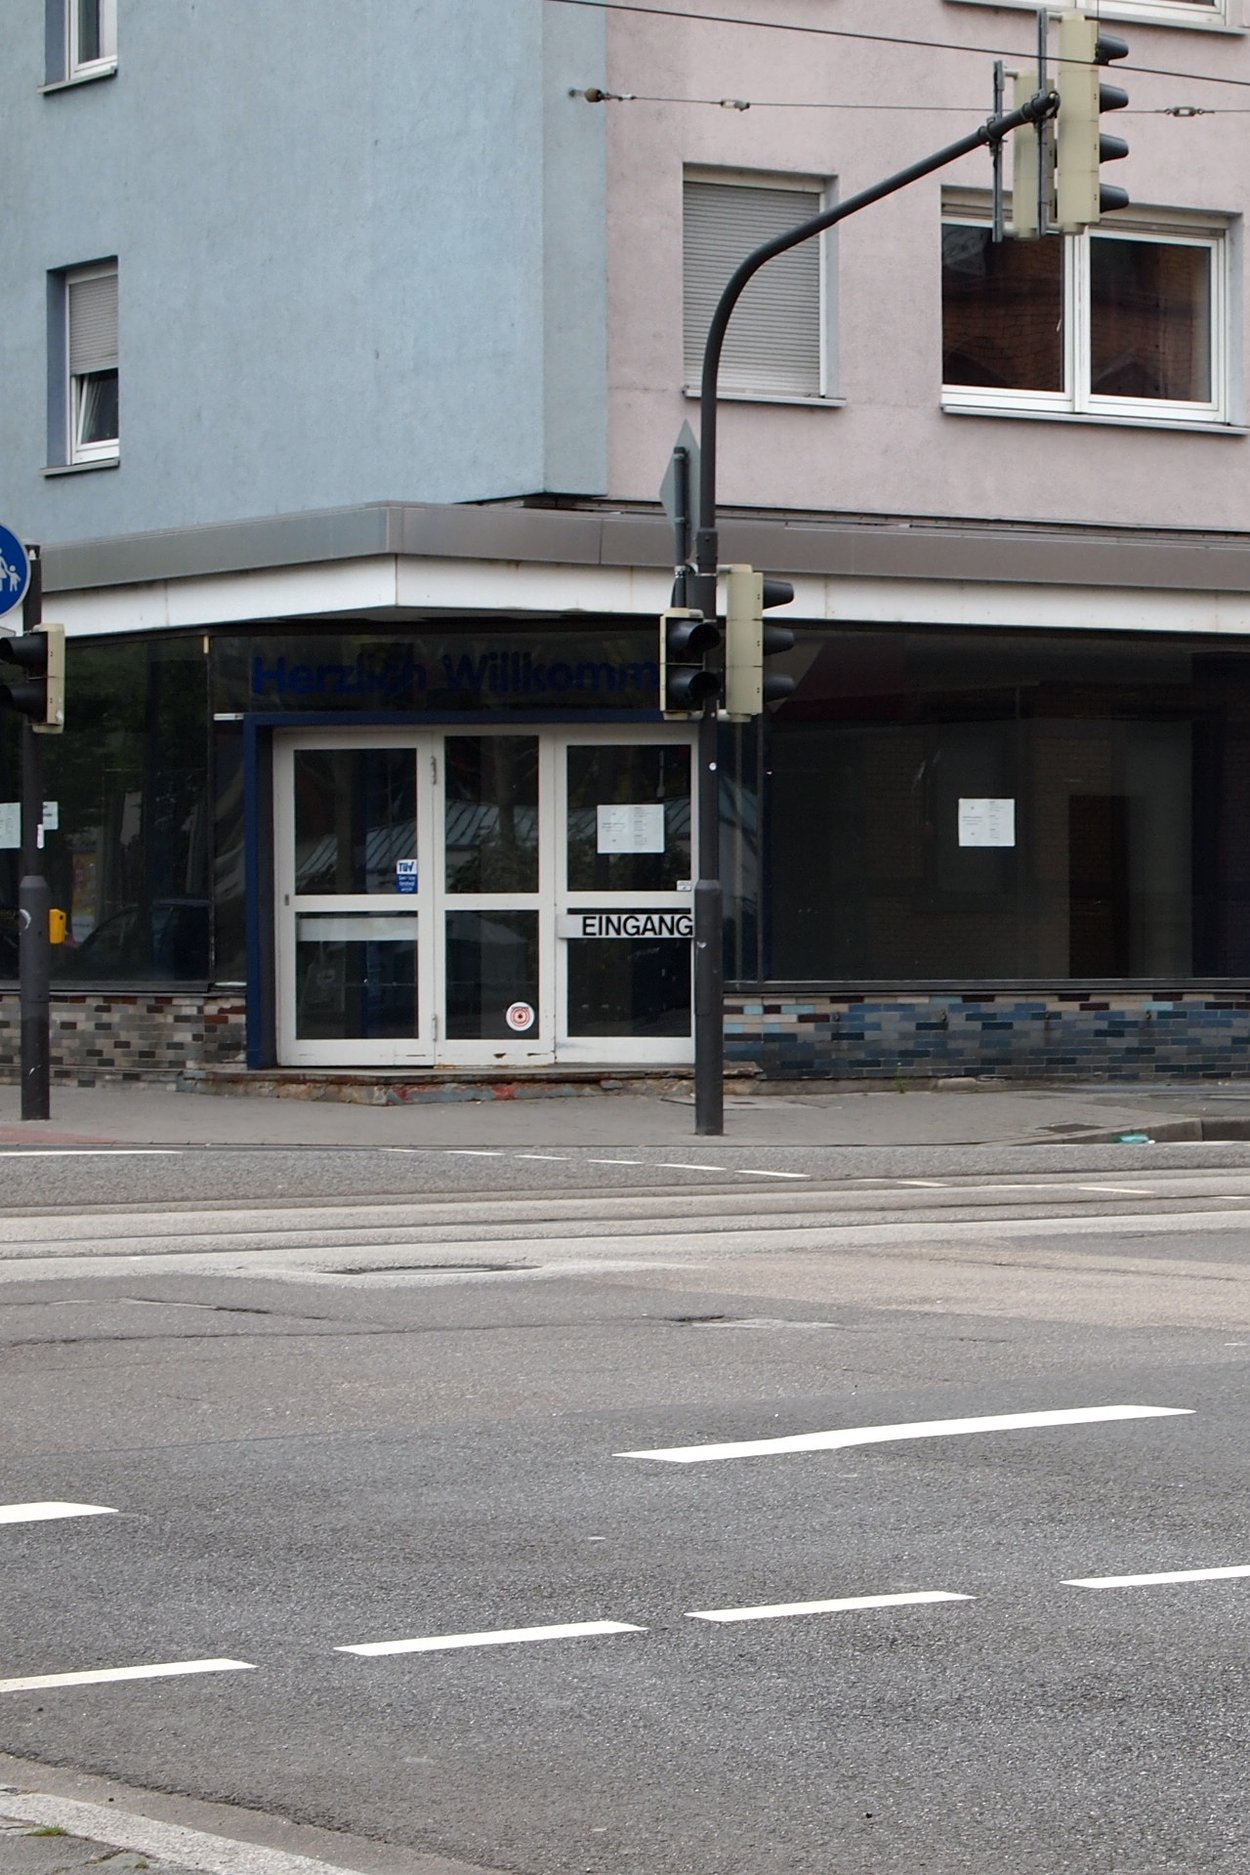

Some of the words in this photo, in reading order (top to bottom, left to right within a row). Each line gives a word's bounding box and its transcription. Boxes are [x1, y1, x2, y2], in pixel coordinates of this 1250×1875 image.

[252, 655, 428, 695] Herzlich
[443, 650, 660, 693] Willkomm
[582, 915, 694, 936] EINGANG
